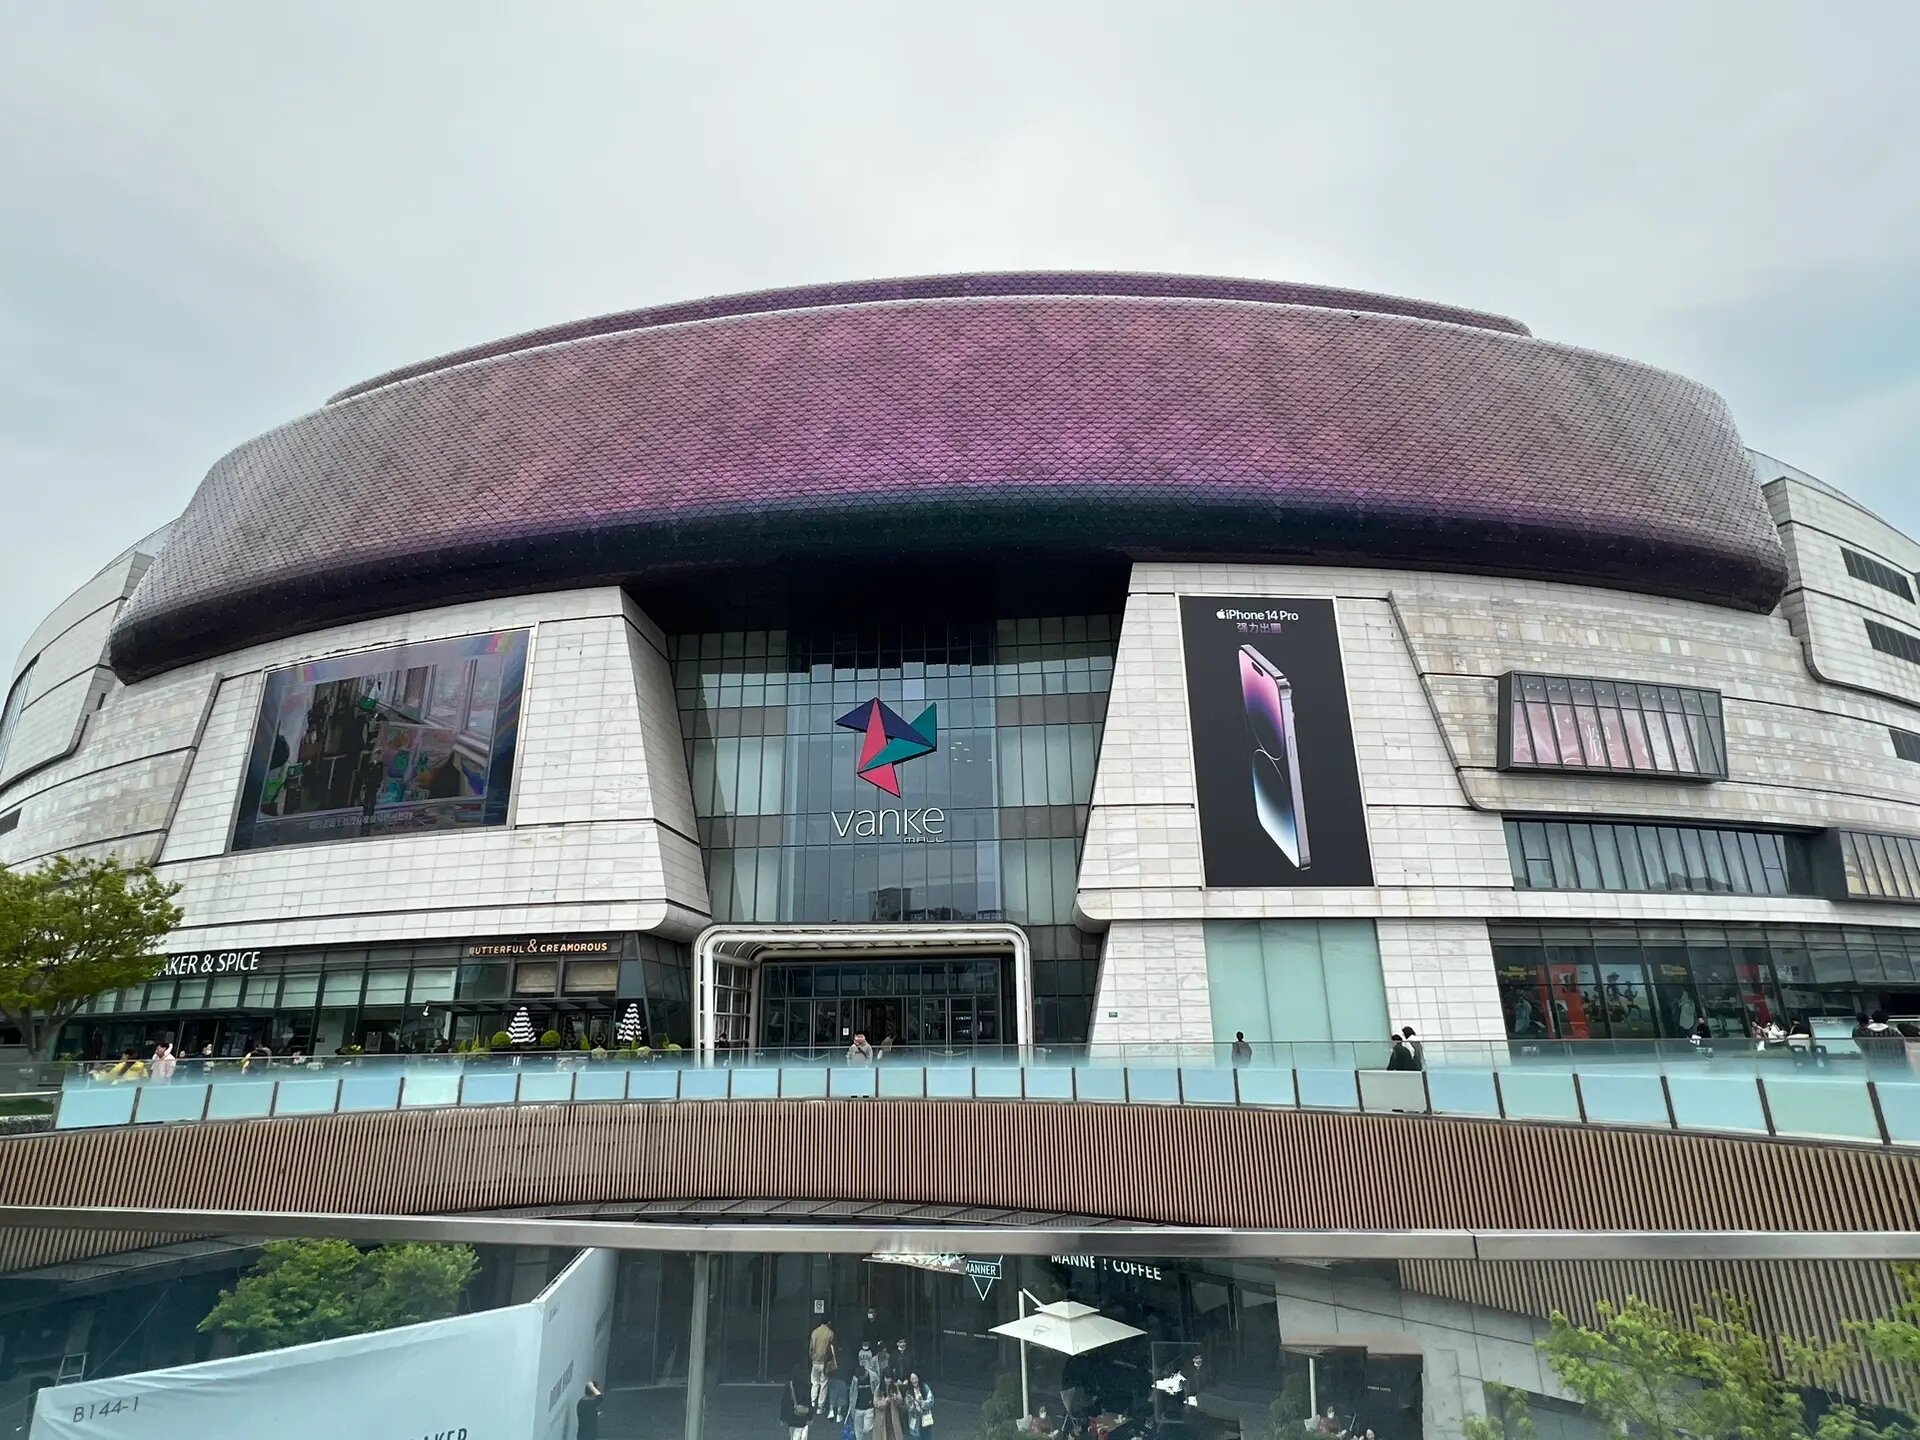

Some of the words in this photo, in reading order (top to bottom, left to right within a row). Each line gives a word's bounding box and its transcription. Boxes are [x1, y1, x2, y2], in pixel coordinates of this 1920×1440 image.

[1226, 609, 1265, 620] iPhone
[1265, 610, 1278, 620] 14
[1279, 610, 1299, 621] Pro
[831, 807, 945, 837] vanke
[469, 945, 525, 955] BUTTERFUL
[527, 938, 538, 953] &
[540, 942, 608, 953] CREAMOROUS
[154, 955, 198, 976] AKER
[200, 954, 215, 973] &
[216, 951, 260, 972] SPICE
[1113, 1259, 1162, 1280] COFFEE
[73, 1396, 139, 1423] B144-1
